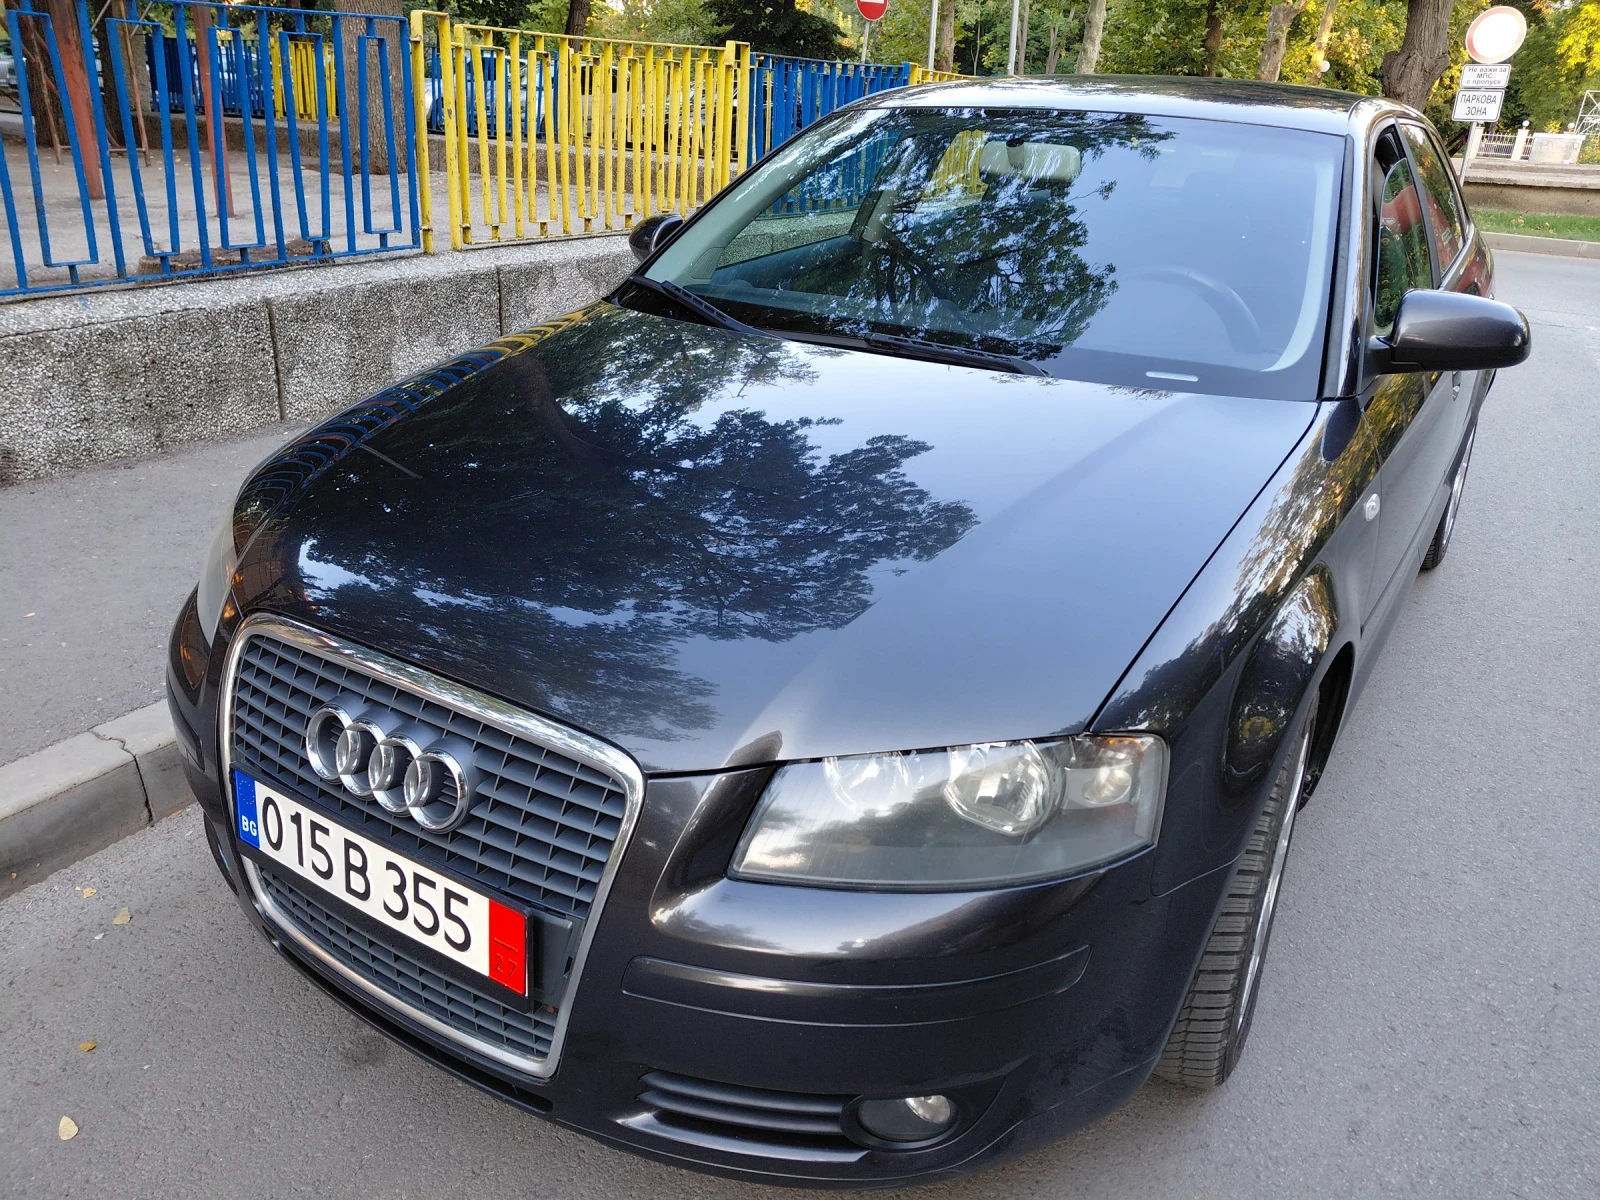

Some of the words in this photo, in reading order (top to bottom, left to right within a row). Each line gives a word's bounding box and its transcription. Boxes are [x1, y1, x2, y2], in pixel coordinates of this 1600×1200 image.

[1460, 94, 1497, 104] ПАРКОВА
[1465, 106, 1487, 116] ЗОНА
[241, 814, 258, 837] BG
[262, 796, 334, 881] 015
[343, 837, 371, 902] B
[383, 861, 472, 953] 355
[494, 952, 518, 977] 27
